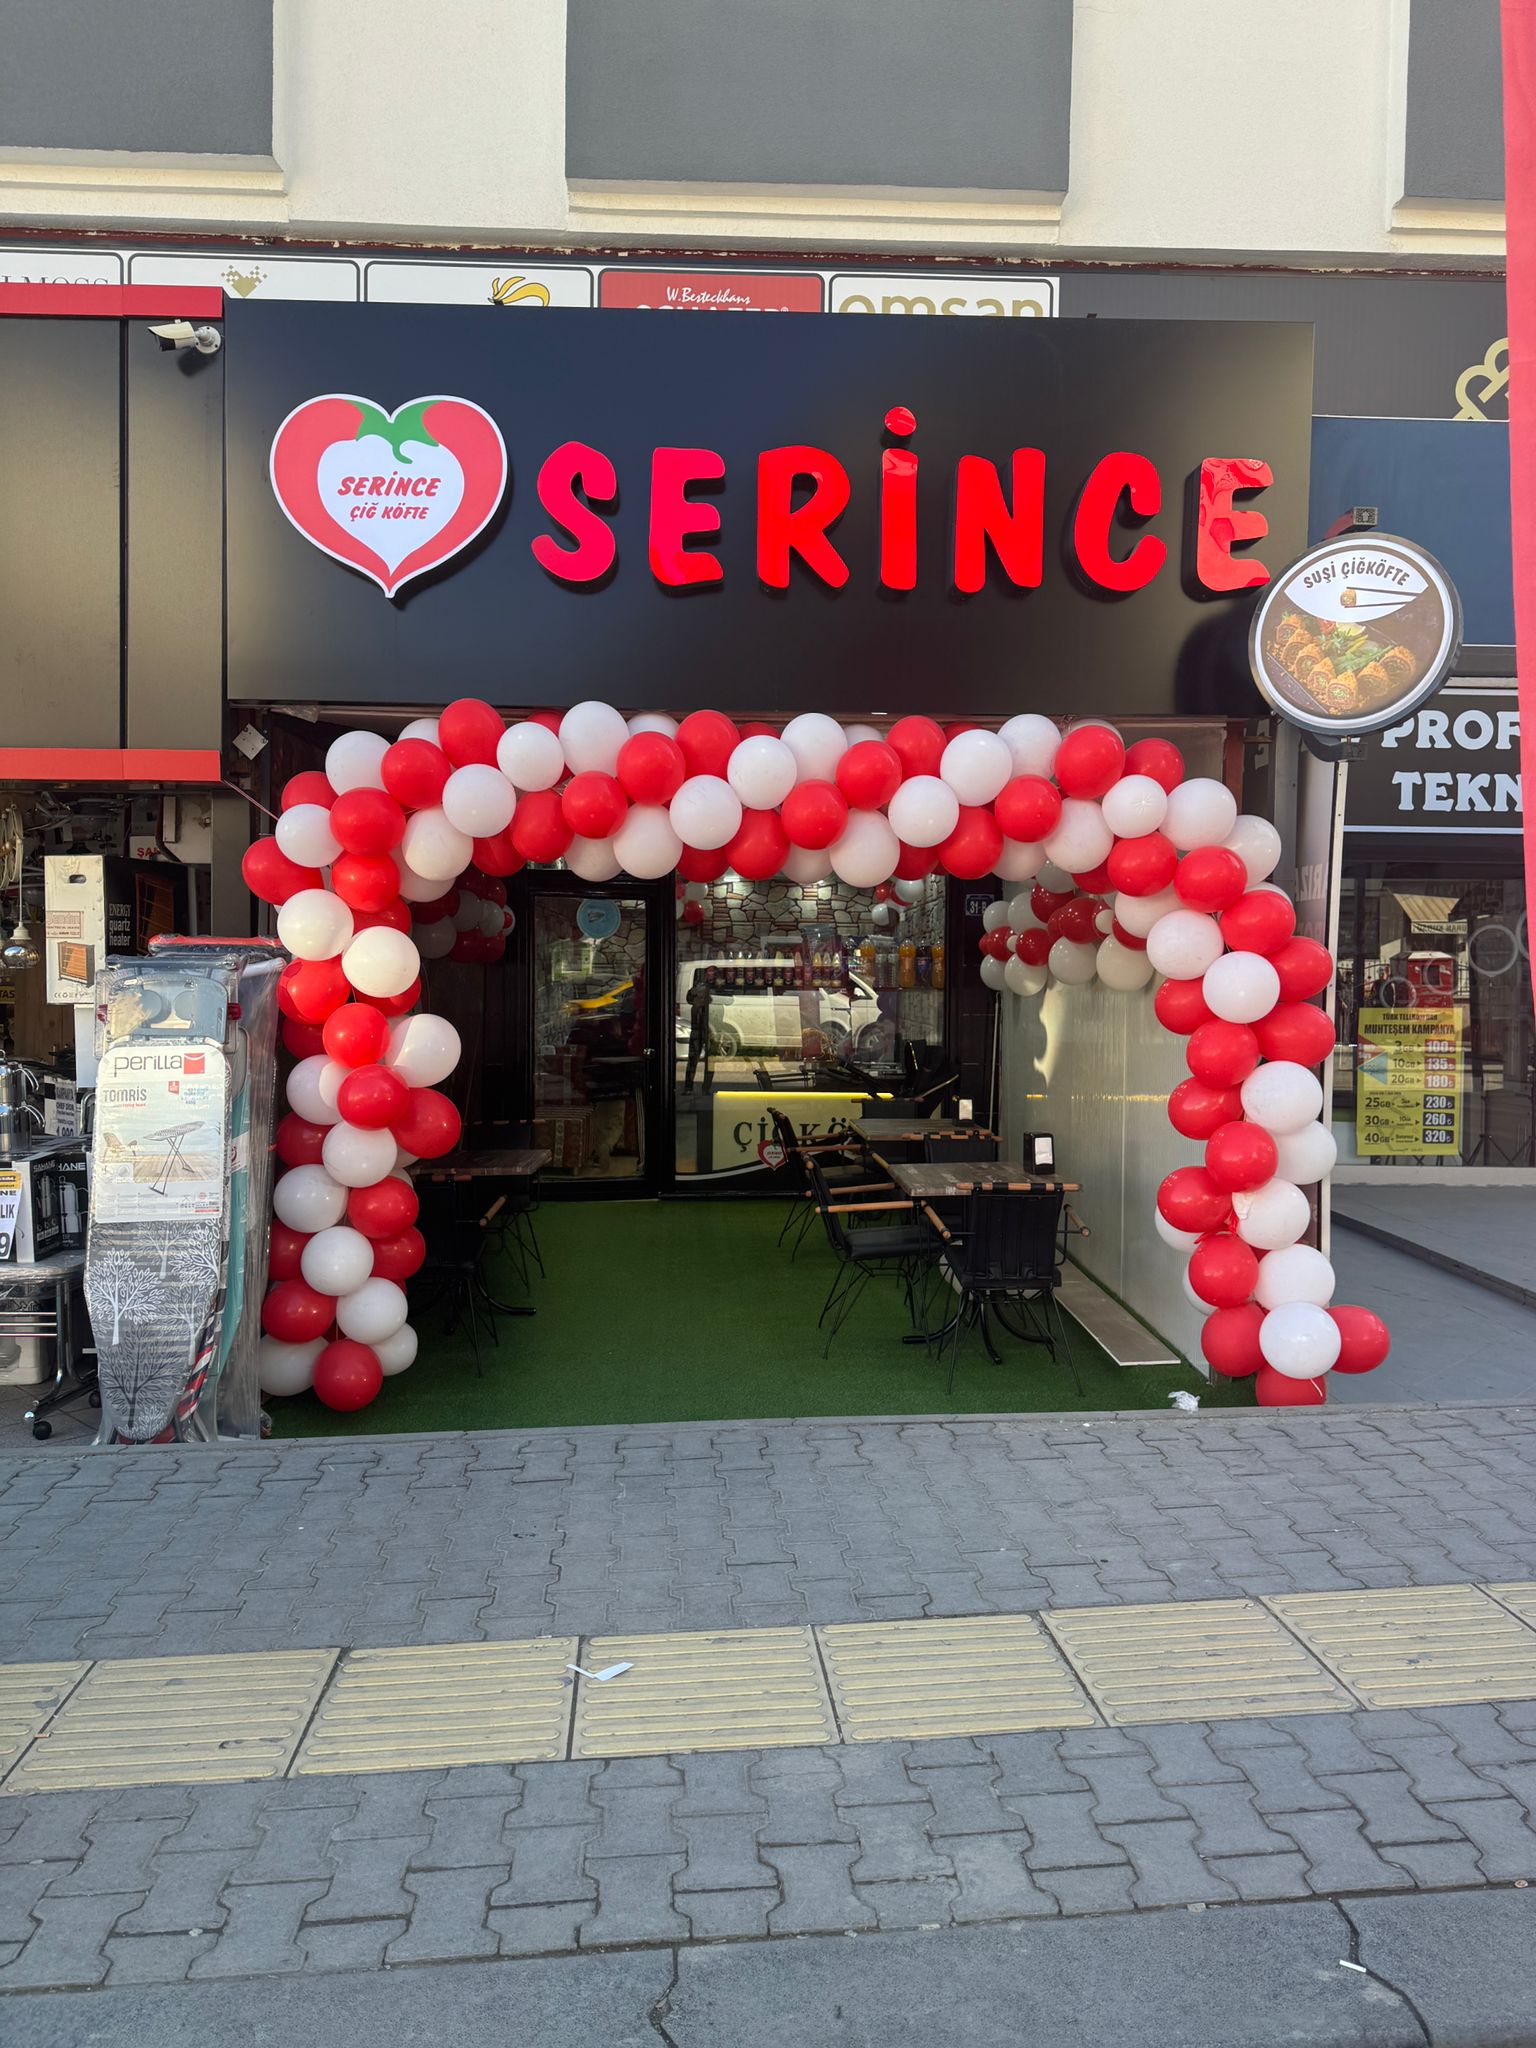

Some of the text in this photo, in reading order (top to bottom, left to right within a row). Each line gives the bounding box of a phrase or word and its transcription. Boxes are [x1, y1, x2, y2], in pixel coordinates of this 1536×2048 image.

[337, 470, 442, 497] SERİNCE
[531, 406, 1274, 593] SERİNCE
[350, 502, 430, 522] ÇİĞ KÖFTE
[1303, 557, 1410, 588] SUŞİ ÇİĞKÖFTE
[1391, 771, 1523, 812] TEKN
[109, 918, 131, 934] quartz
[109, 932, 131, 946] heater
[1364, 1024, 1455, 1036] MUHTEŞEM KAMPANYA
[114, 1055, 182, 1077] perilla
